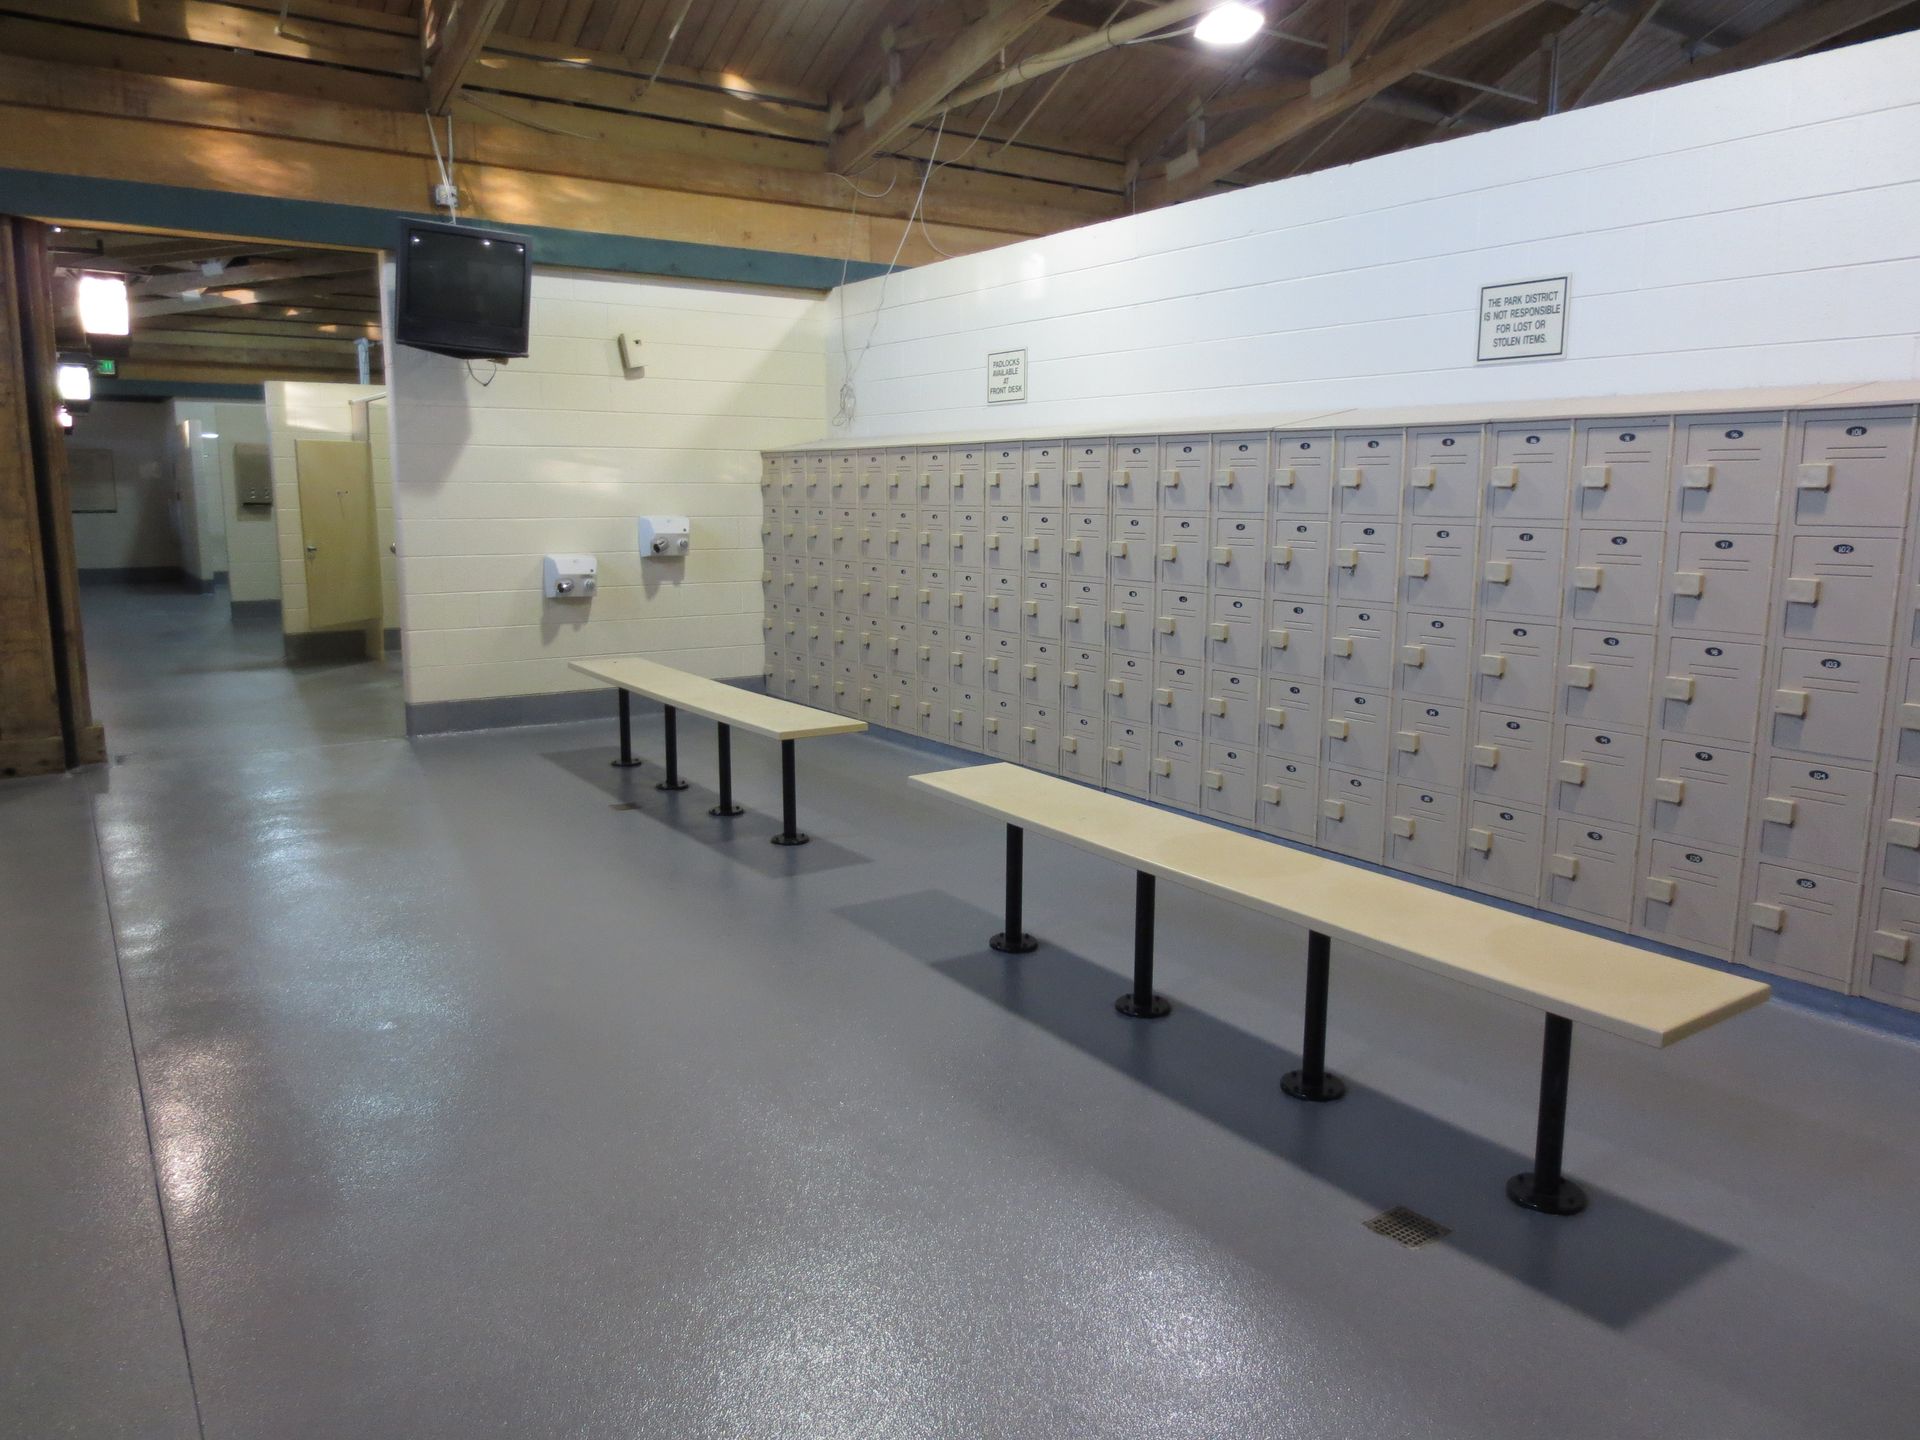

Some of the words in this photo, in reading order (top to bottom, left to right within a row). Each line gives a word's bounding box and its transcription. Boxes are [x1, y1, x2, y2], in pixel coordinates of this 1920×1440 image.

[1488, 298, 1502, 308] THE
[1504, 295, 1522, 306] PARK
[1525, 291, 1559, 304] DISTRICT
[1483, 312, 1491, 321] IS
[1493, 309, 1508, 320] NOT
[1510, 304, 1561, 318] RESPONSIBLE
[1496, 323, 1511, 333] FOR
[1513, 321, 1532, 332] LOST
[1535, 319, 1546, 329] OR
[1492, 336, 1520, 348] STOLEN
[1523, 334, 1547, 345] ITEMS.
[993, 358, 1020, 368] PADLOCKS
[992, 367, 1019, 376] AVAILABLE
[990, 387, 1007, 395] FRONT
[1008, 385, 1022, 393] DESK
